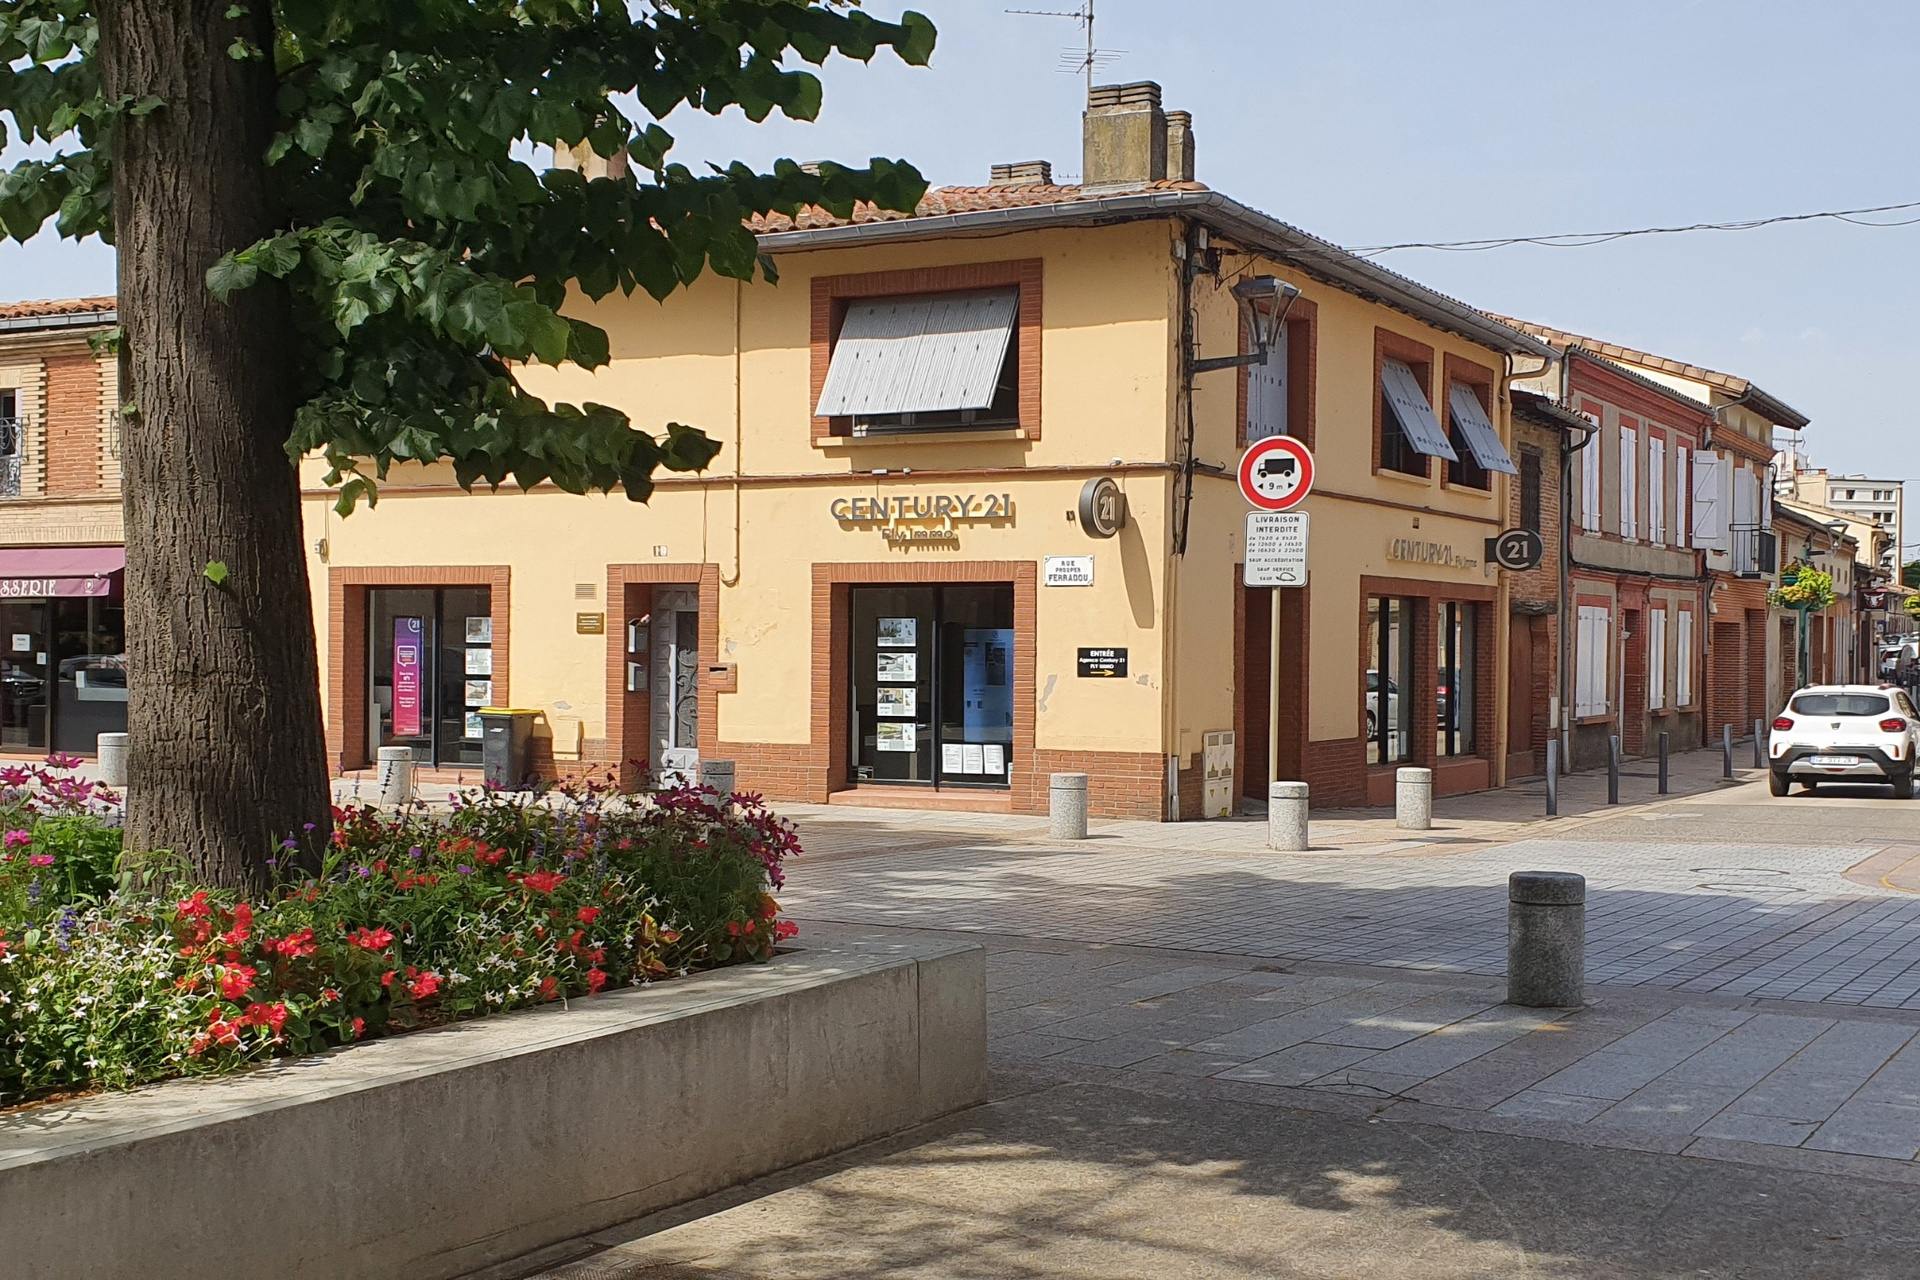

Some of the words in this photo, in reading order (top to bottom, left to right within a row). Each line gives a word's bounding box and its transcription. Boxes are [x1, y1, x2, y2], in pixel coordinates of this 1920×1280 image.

[1268, 482, 1275, 490] 9
[830, 494, 976, 521] CENTURY
[984, 493, 1011, 518] 21
[1099, 495, 1116, 521] 21
[1392, 538, 1442, 563] CENTURY
[1442, 545, 1452, 566] 21
[1506, 540, 1528, 559] 21
[1048, 573, 1089, 582] FERRADOU
[1090, 649, 1115, 657] ENTRÉE
